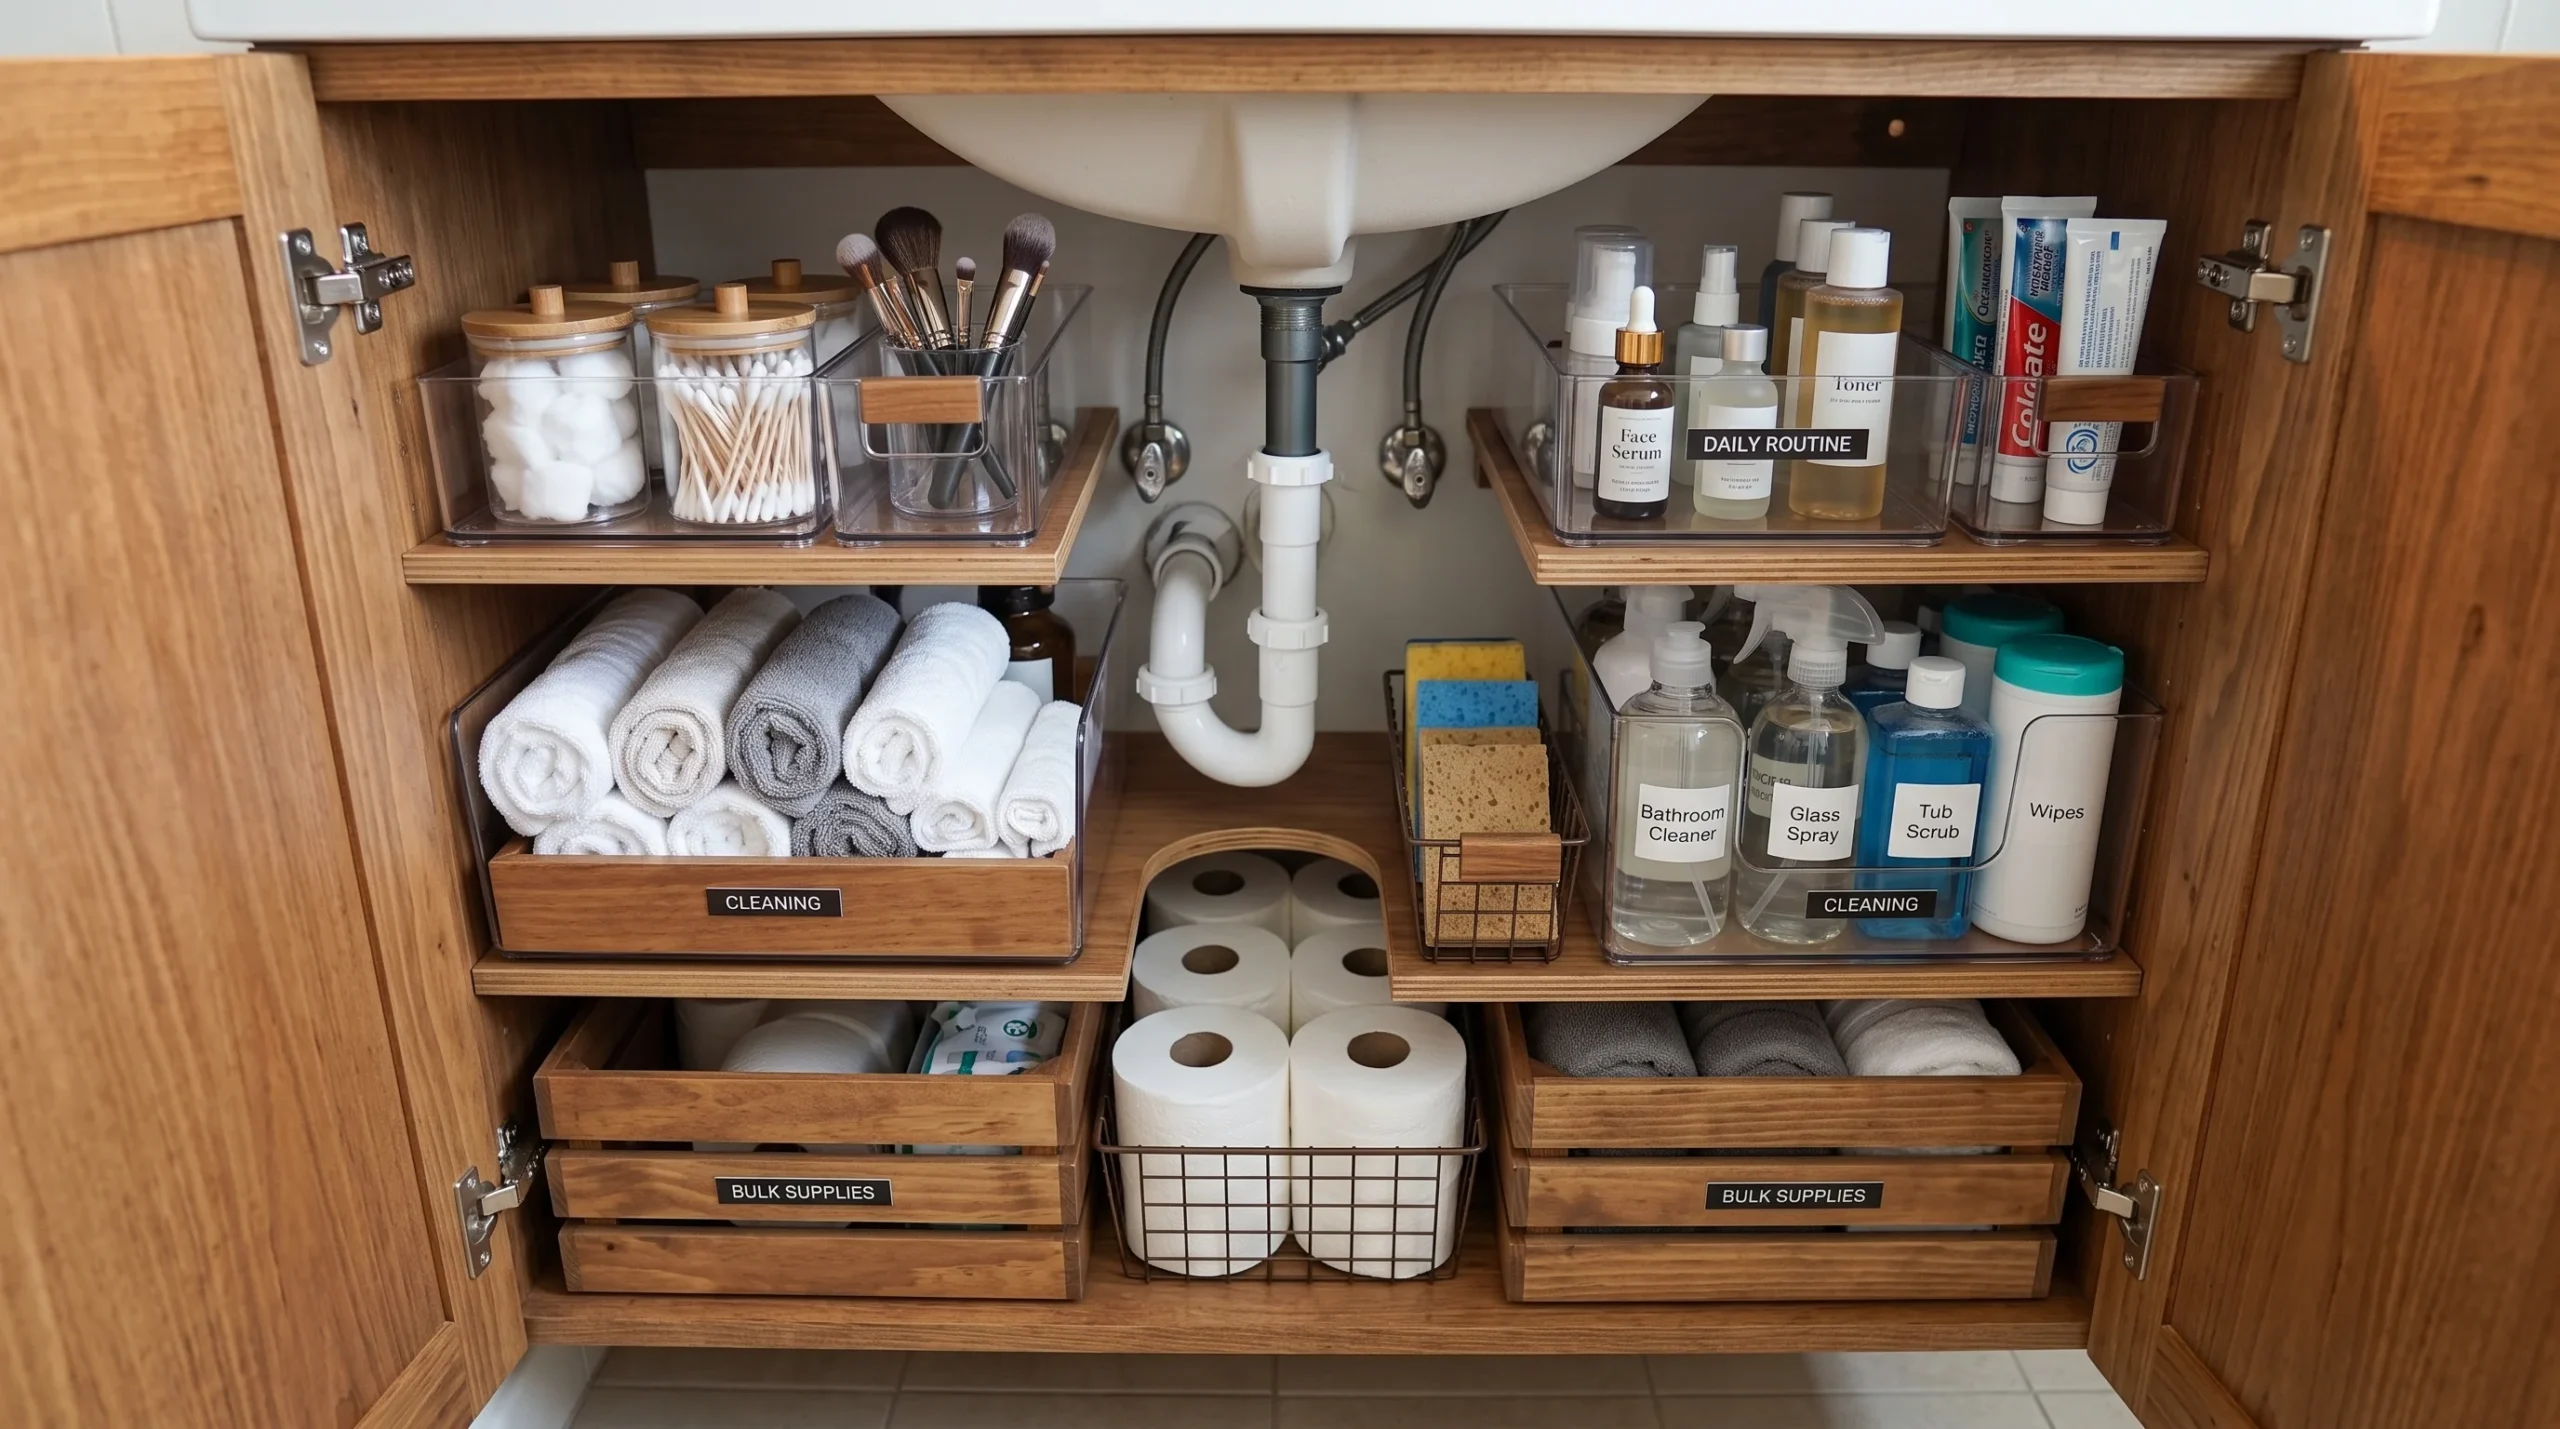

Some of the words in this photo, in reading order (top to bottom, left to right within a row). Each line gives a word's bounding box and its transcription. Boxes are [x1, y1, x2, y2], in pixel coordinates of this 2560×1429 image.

[1834, 375, 1882, 392] Toner
[1621, 428, 1657, 443] Face
[1611, 444, 1662, 460] Serum
[1703, 435, 1761, 453] DAILY
[1766, 435, 1852, 453] ROUTINE
[1641, 803, 1725, 823] Bathroom
[1789, 806, 1841, 823] Glass
[1919, 803, 1953, 819] Tub
[2029, 802, 2085, 823] Wipes
[1649, 826, 1717, 843] Cleaner
[1786, 826, 1840, 845] Spray
[1906, 823, 1960, 839] Scrub
[725, 895, 822, 911] CLEANING
[1824, 897, 1919, 912] CLEANING
[731, 1184, 780, 1199] BULK
[785, 1185, 875, 1200] SUPPLIES
[1722, 1189, 1771, 1203] BULK
[1776, 1188, 1866, 1203] SUPPLIES
